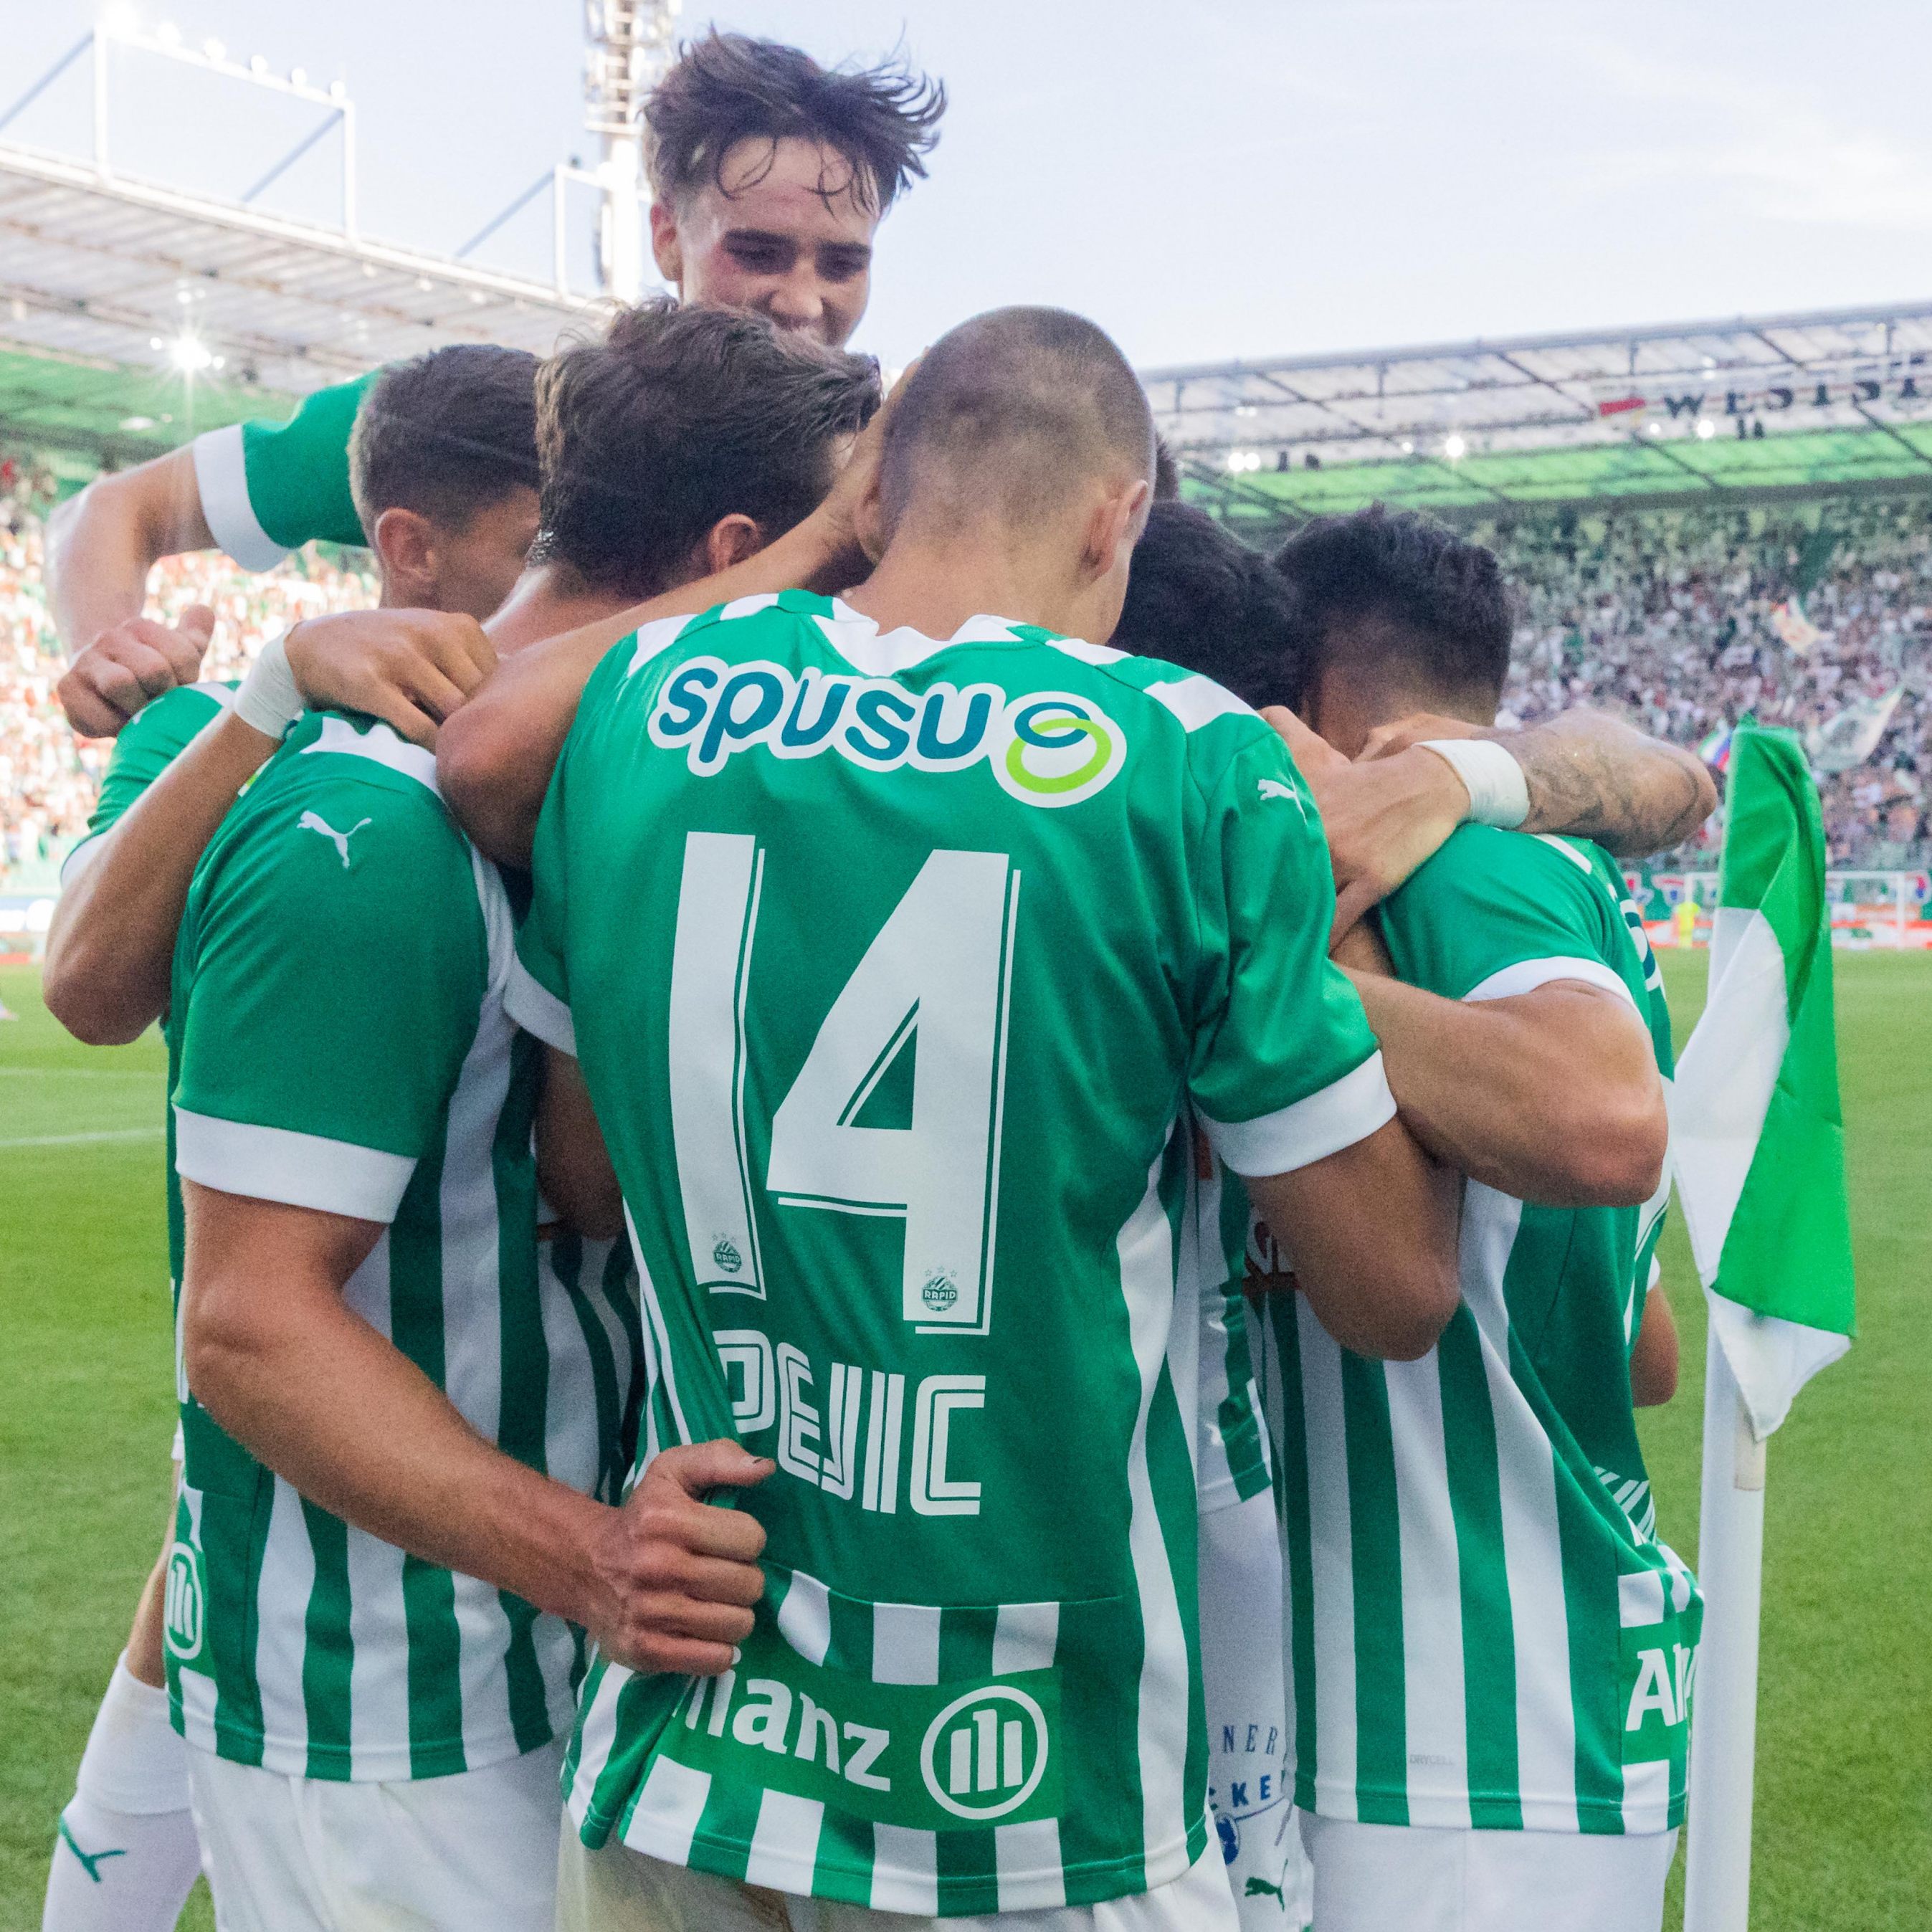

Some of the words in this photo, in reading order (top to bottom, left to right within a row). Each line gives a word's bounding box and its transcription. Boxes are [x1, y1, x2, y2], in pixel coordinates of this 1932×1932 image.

[658, 666, 992, 764] spusu
[668, 831, 1022, 1336] 14
[924, 1290, 956, 1300] RAPID
